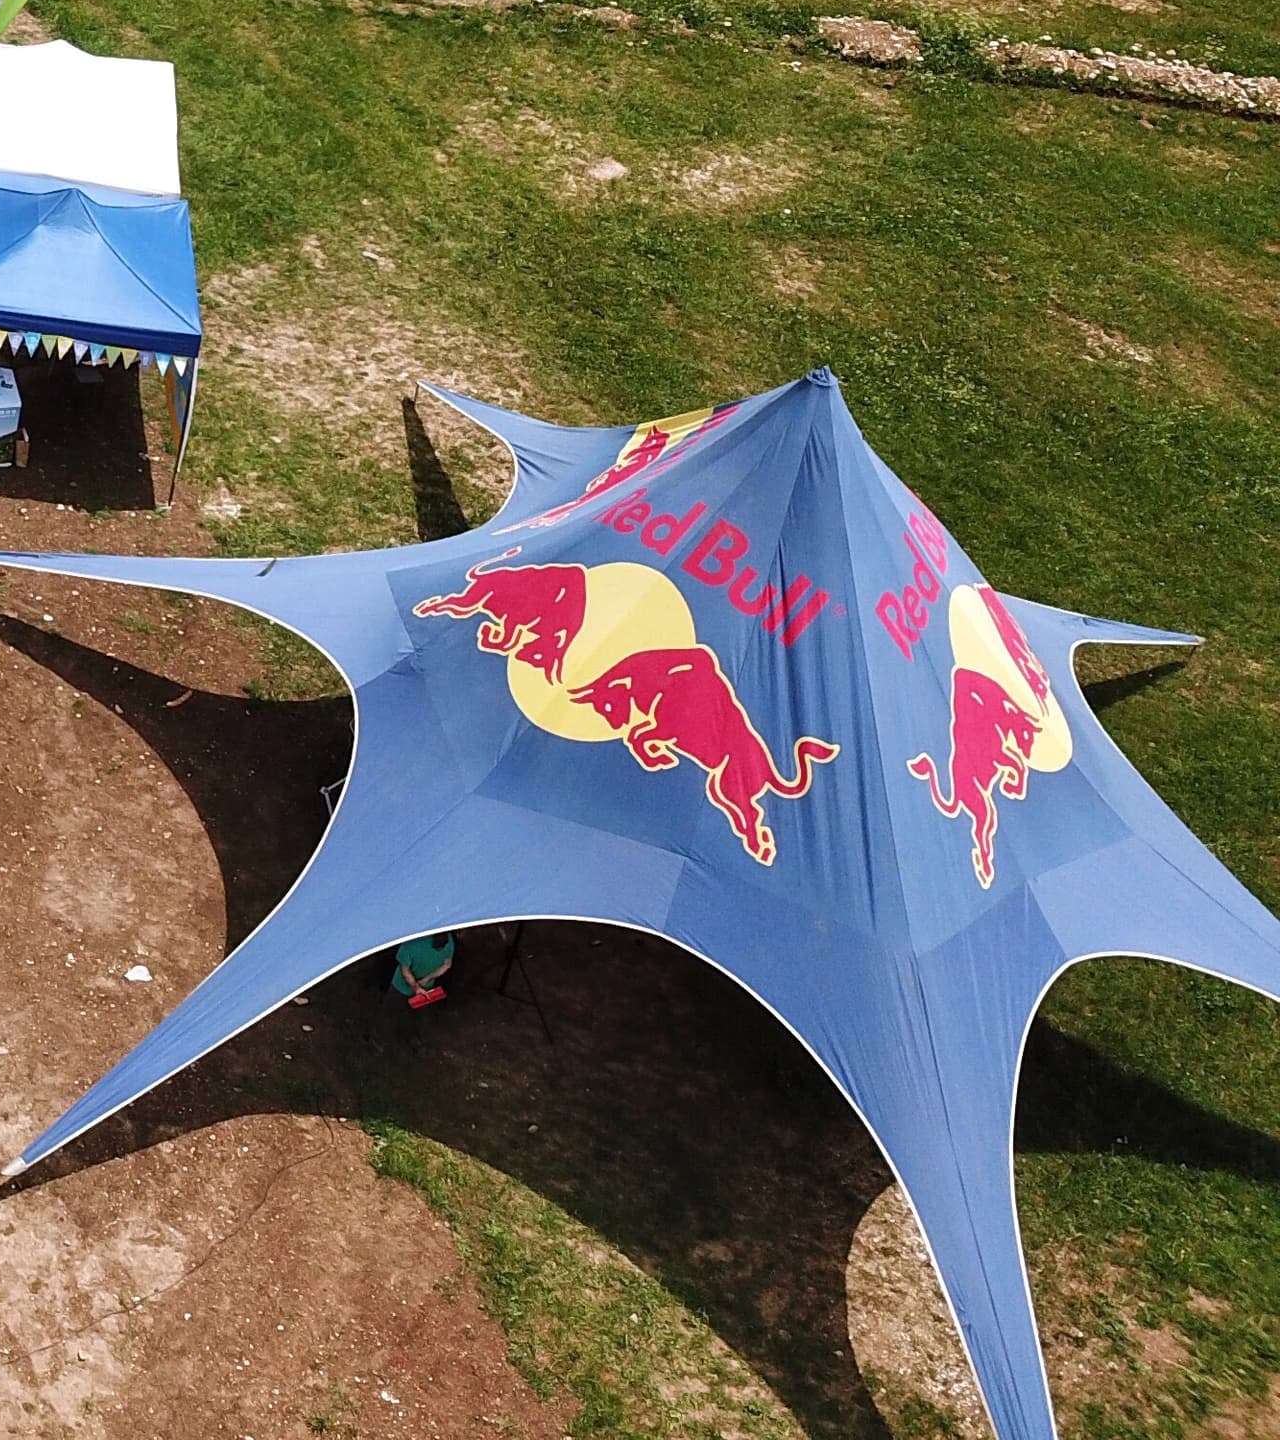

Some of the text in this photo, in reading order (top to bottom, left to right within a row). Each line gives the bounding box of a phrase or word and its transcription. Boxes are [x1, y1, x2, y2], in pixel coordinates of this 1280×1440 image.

[592, 487, 831, 648] Red Bull
[874, 531, 942, 662] Red
